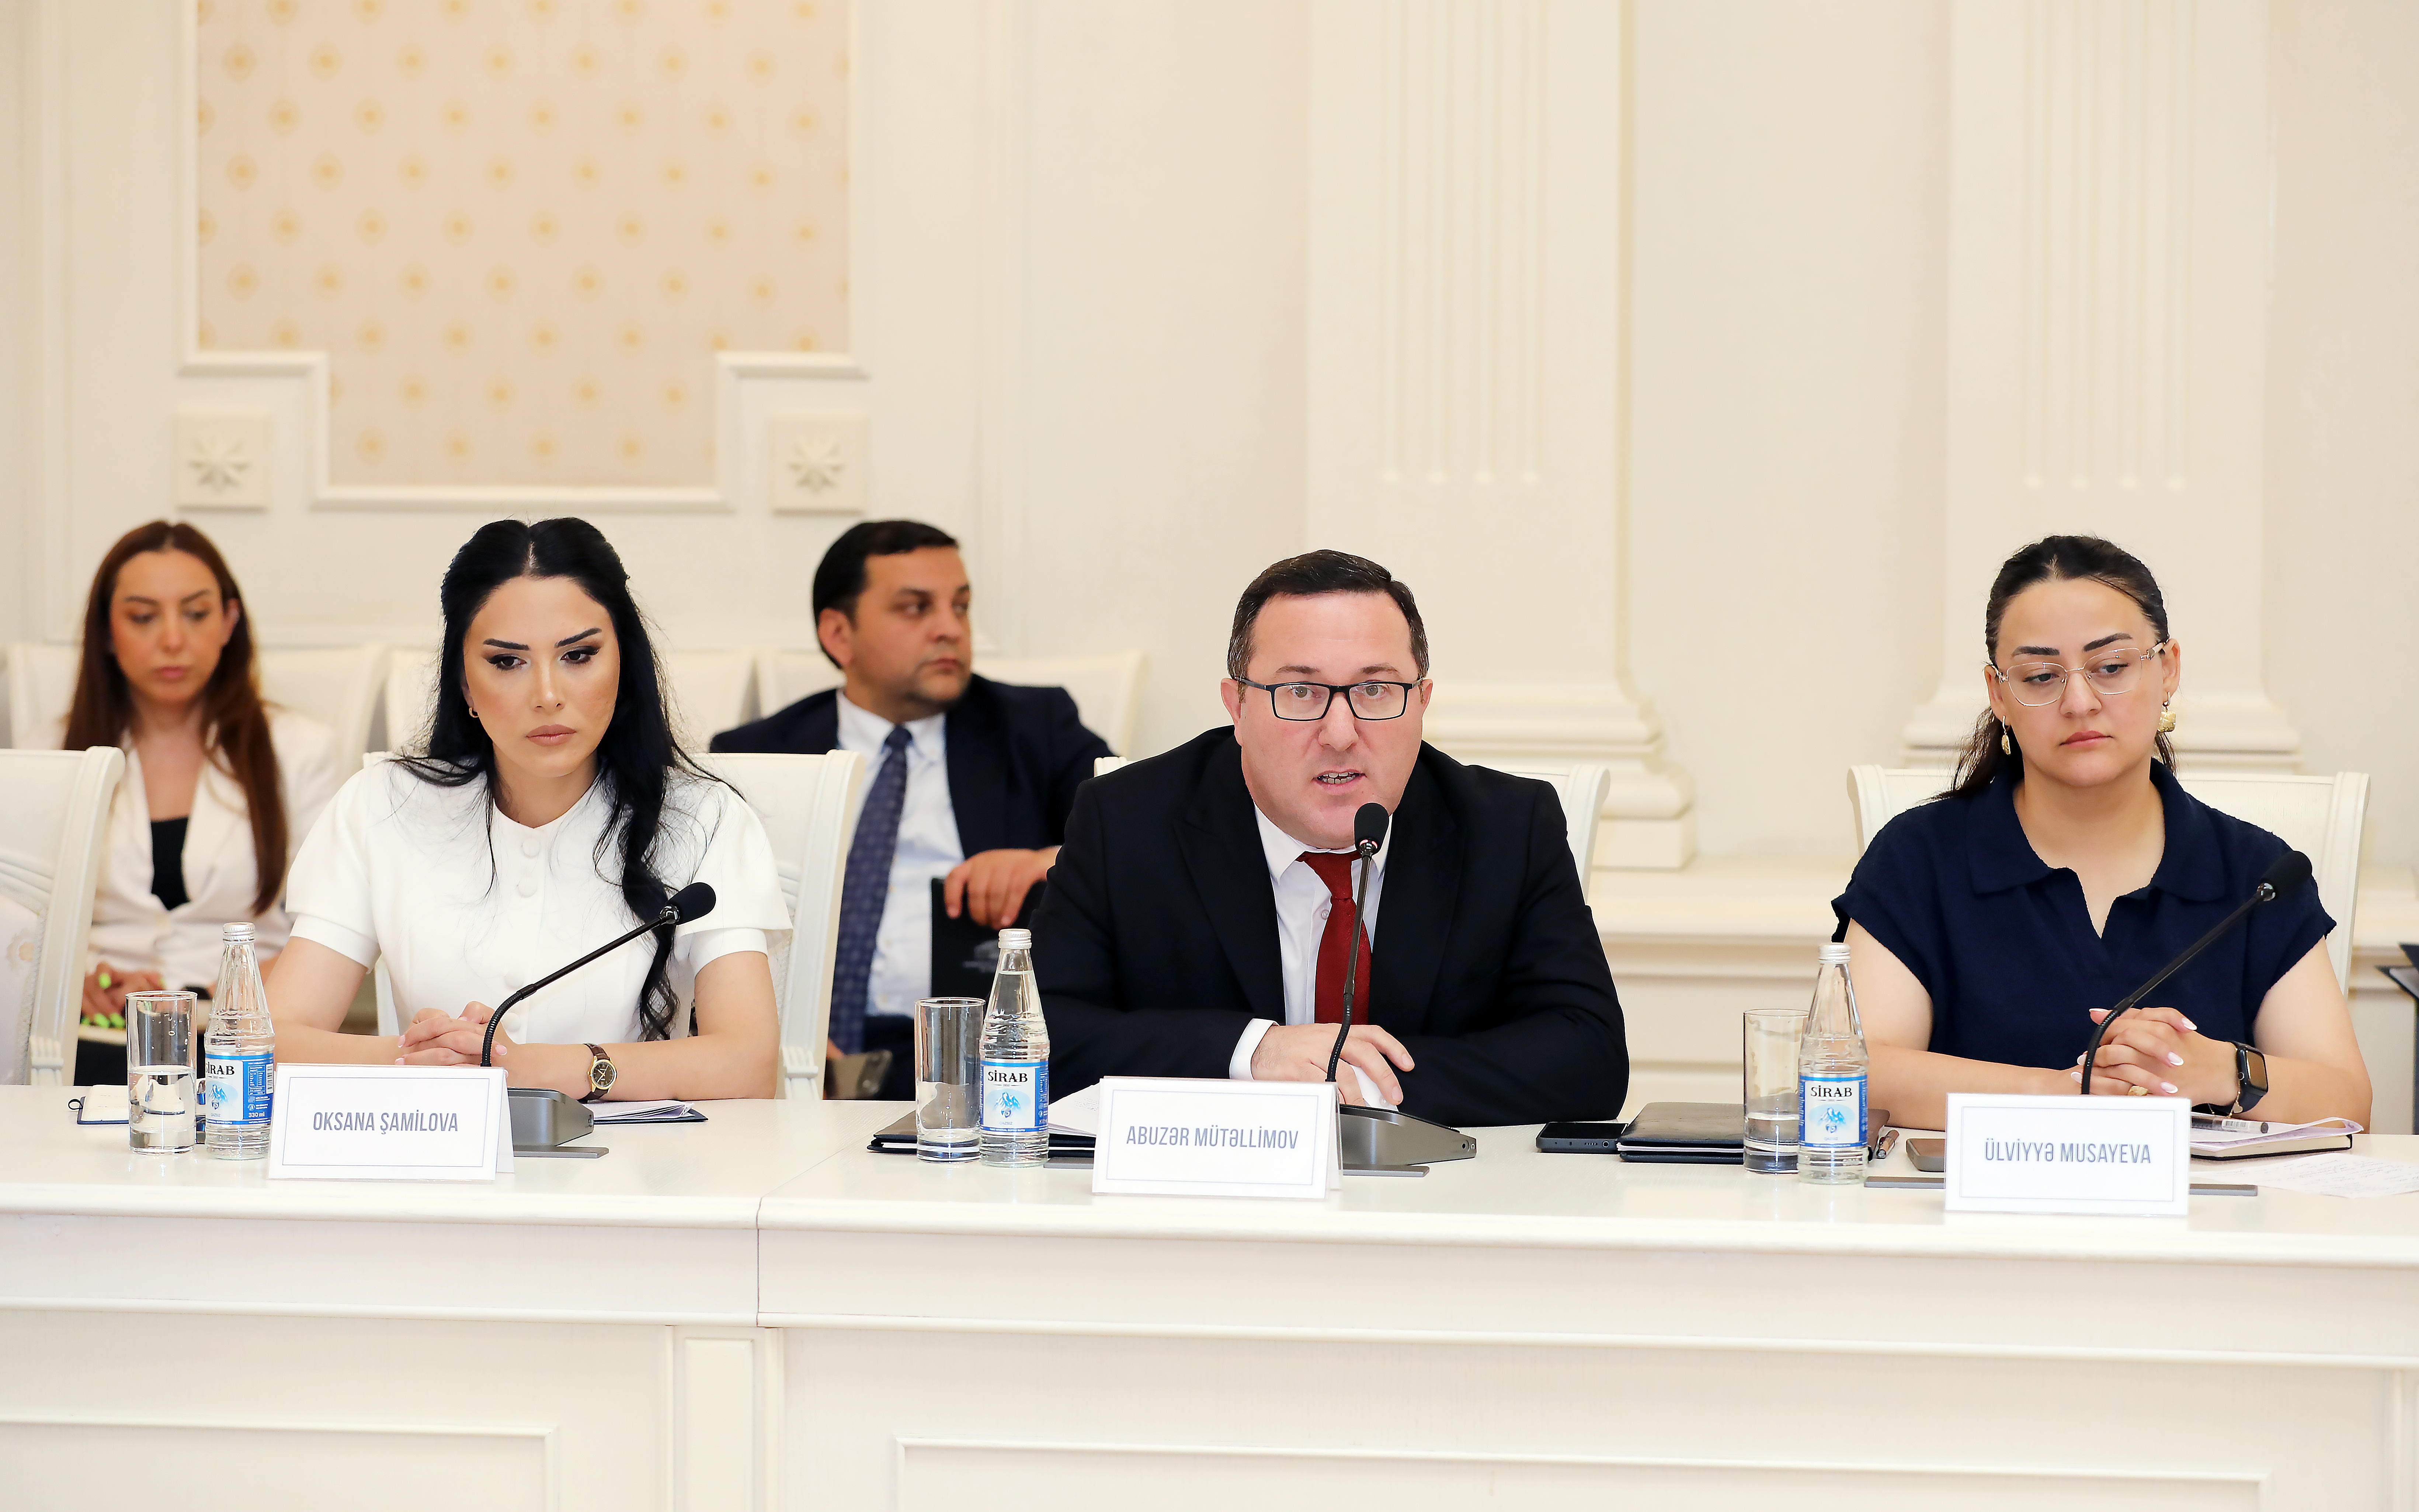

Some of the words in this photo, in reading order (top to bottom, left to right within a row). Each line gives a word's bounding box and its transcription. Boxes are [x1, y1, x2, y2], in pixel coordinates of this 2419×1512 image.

[988, 1070, 1028, 1082] SİRAB
[1811, 1085, 1852, 1097] SİRAB
[313, 1112, 375, 1131] OKSANA
[380, 1109, 458, 1134] ŞAMİLOVA
[1126, 1126, 1189, 1146] ABUZƏR
[1195, 1125, 1298, 1149] MÜTƏLLİMOV
[1985, 1138, 2054, 1161] ÜLVİYYƏ
[2060, 1143, 2151, 1164] MUSAYEVA
